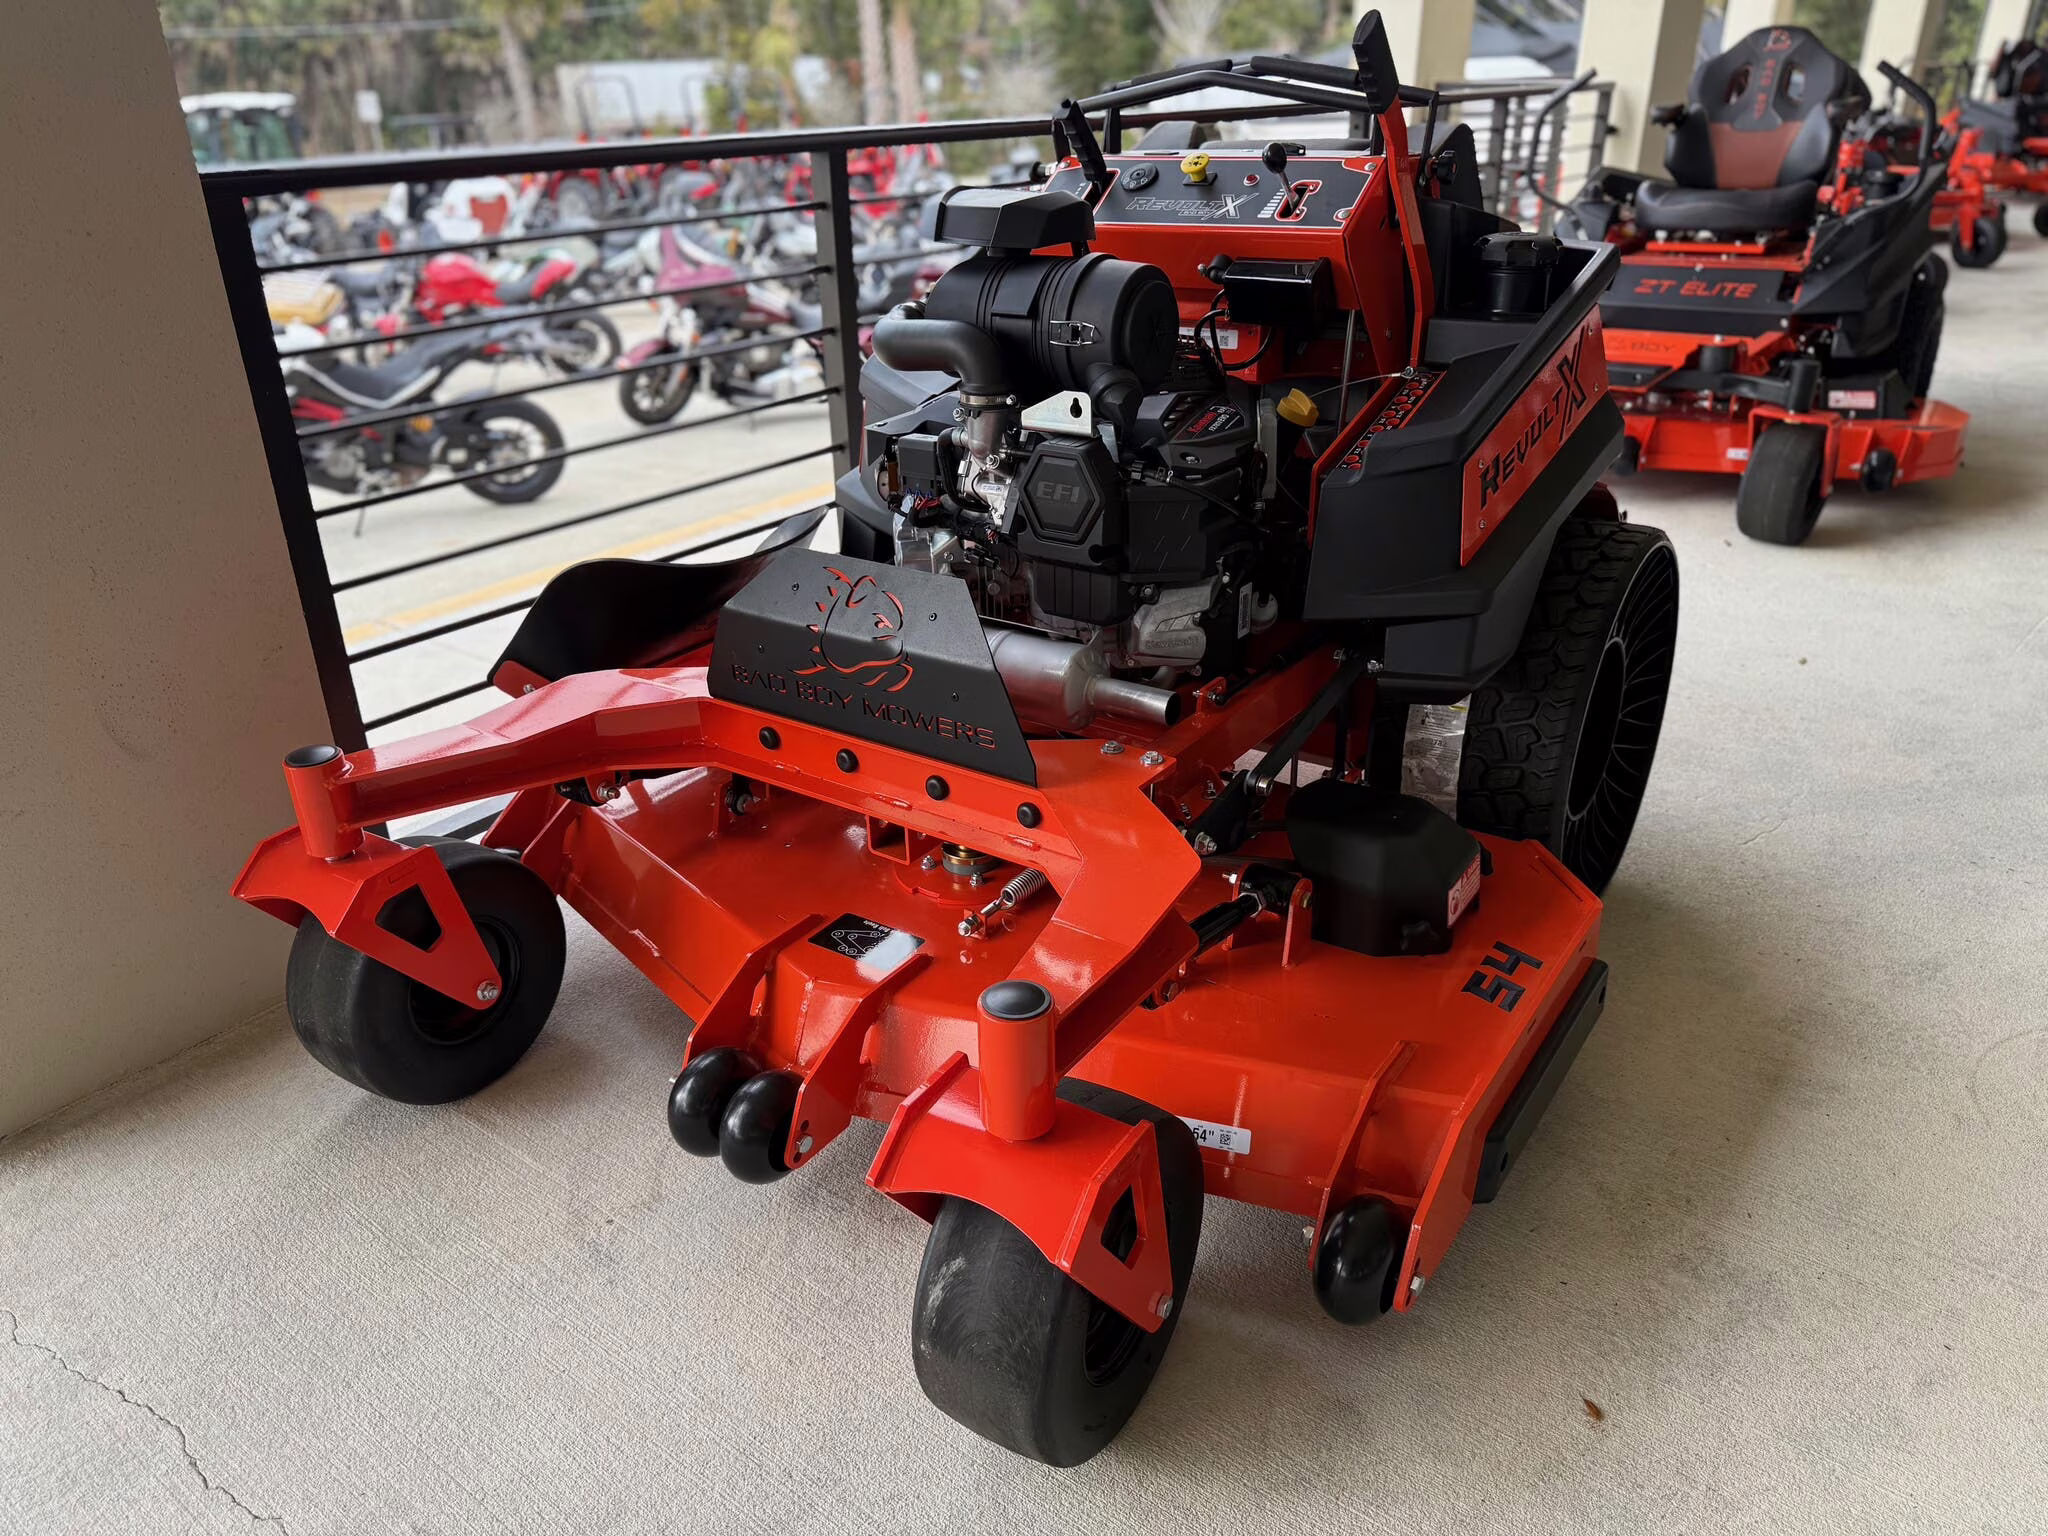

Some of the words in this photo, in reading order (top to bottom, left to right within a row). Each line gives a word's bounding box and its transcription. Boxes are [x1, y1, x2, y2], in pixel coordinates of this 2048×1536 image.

[1634, 278, 1676, 294] ZT
[1680, 280, 1758, 298] ELITE
[1036, 481, 1080, 502] EFI
[731, 664, 787, 694] BAD
[796, 680, 853, 709] BOY
[863, 697, 996, 750] MOWERS
[1461, 941, 1543, 1013] 54
